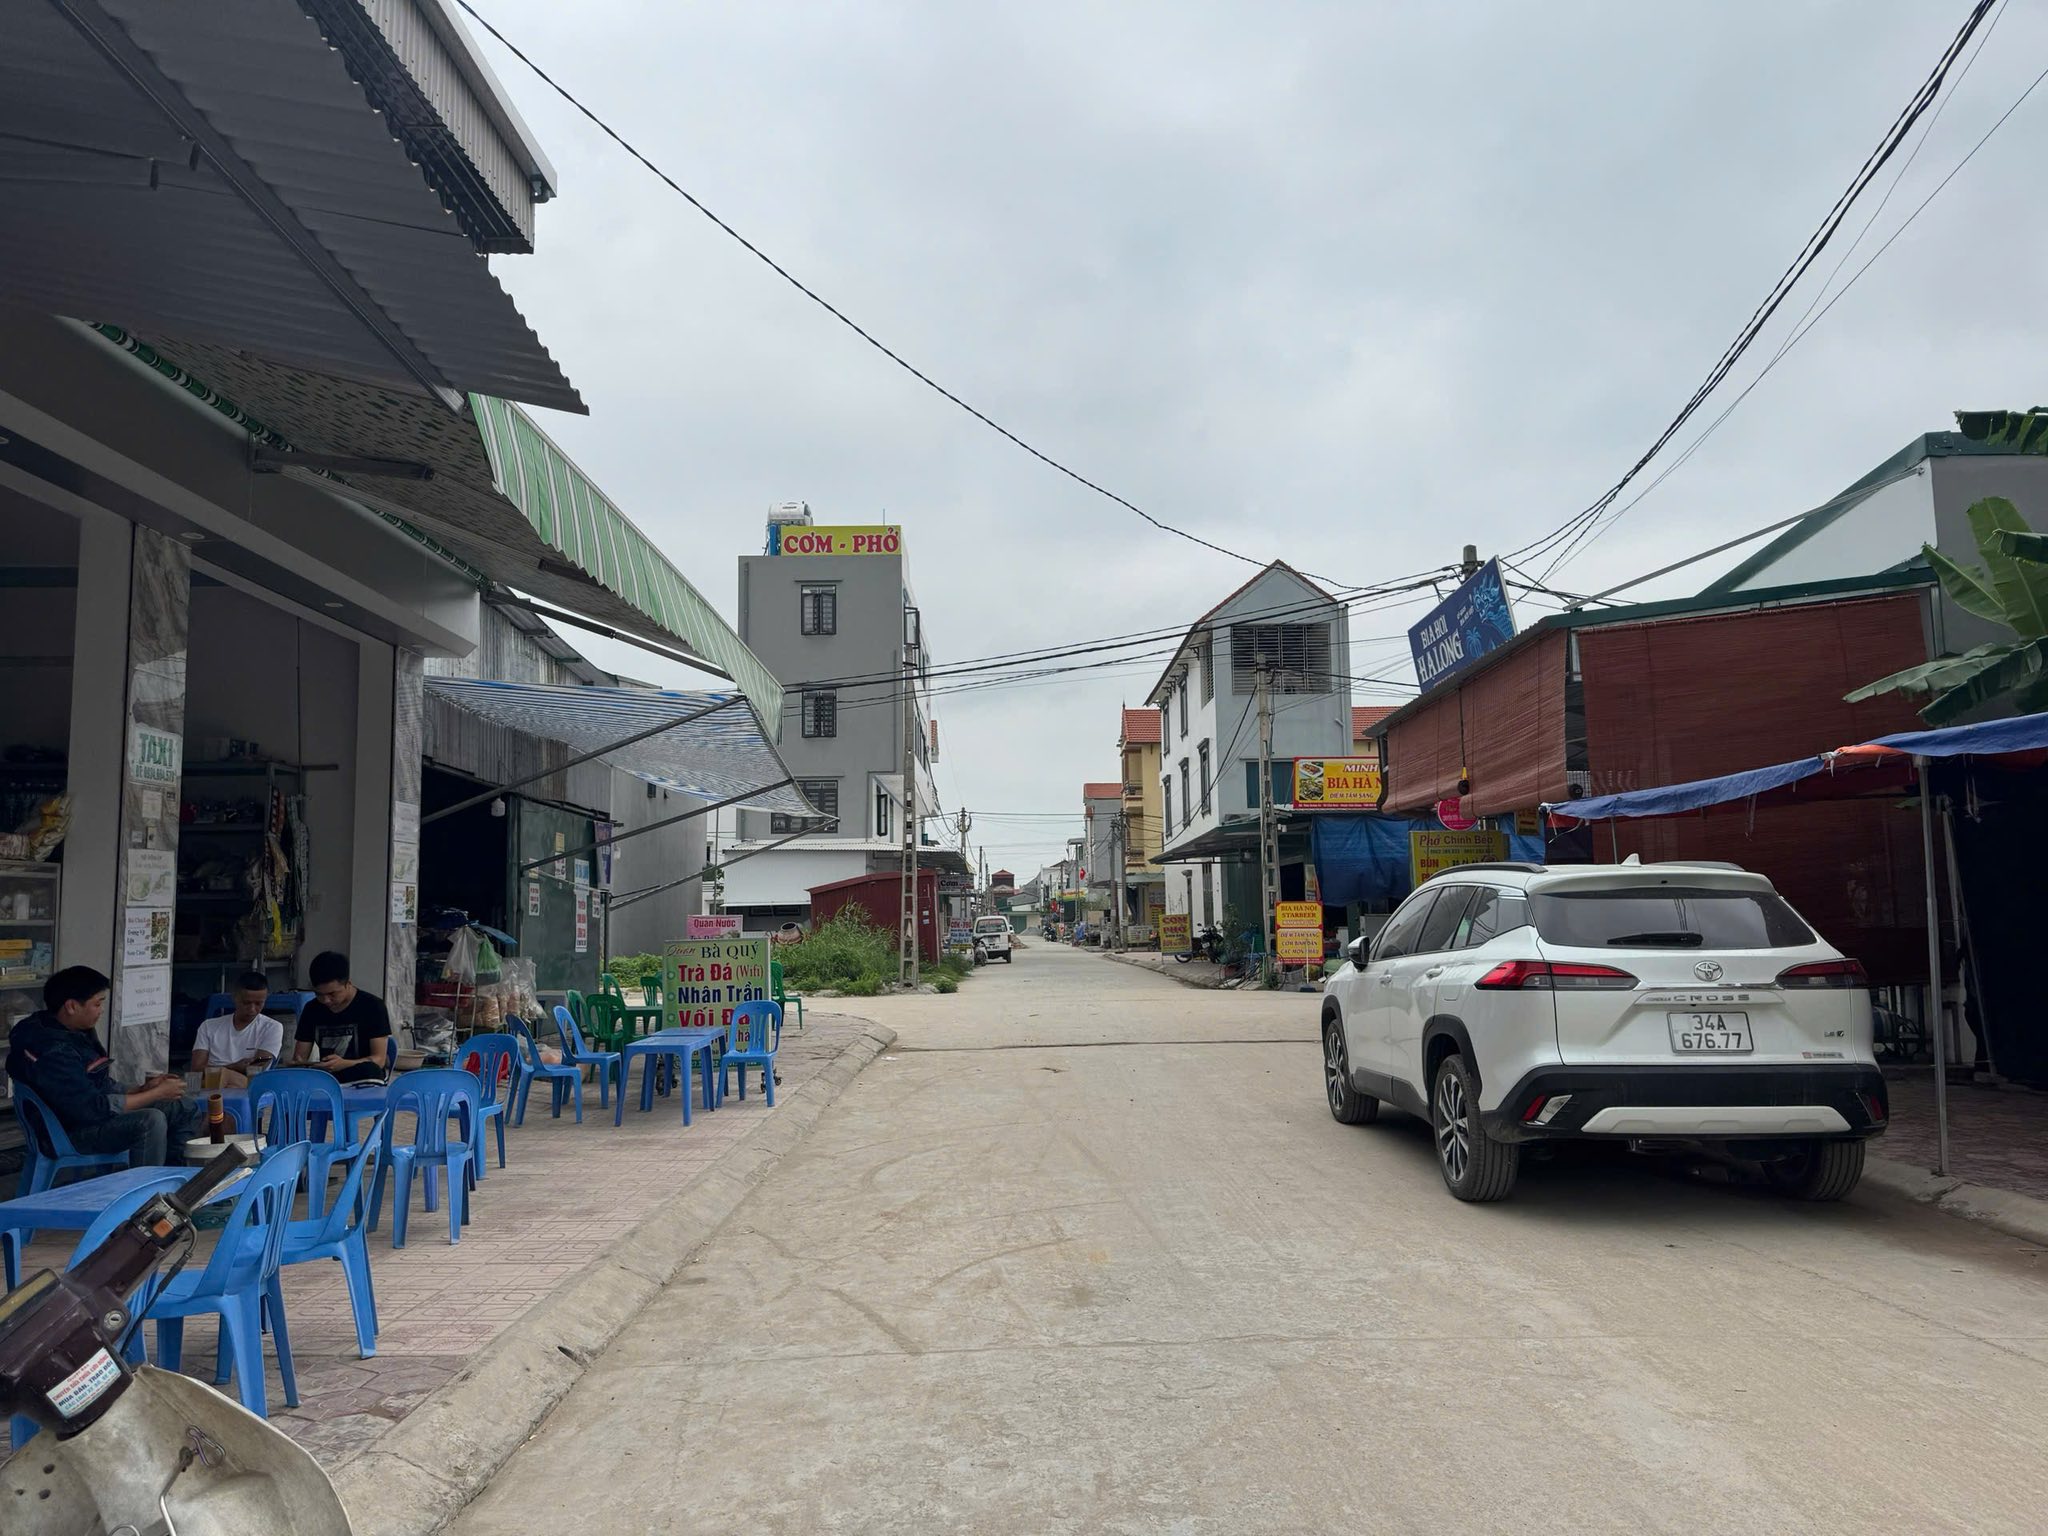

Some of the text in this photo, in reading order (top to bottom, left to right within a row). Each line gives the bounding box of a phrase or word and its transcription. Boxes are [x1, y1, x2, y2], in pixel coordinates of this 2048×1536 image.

[784, 532, 833, 553] CƠM
[853, 528, 899, 553] PHỞ
[1421, 625, 1436, 650] BIA
[139, 733, 174, 768] TAXI
[1344, 764, 1378, 773] MINH
[1327, 777, 1350, 789] BIA
[1353, 774, 1373, 789] HÀ
[701, 943, 721, 959] Bà
[678, 964, 705, 982] Trà
[710, 963, 732, 981] Đá
[678, 981, 762, 1004] Nhân Trần
[1674, 994, 1749, 1002] CROSS
[679, 1007, 714, 1027] Vối
[1691, 1014, 1726, 1031] 34A
[1681, 1033, 1742, 1049] 676.77
[58, 1394, 74, 1407] MUA
